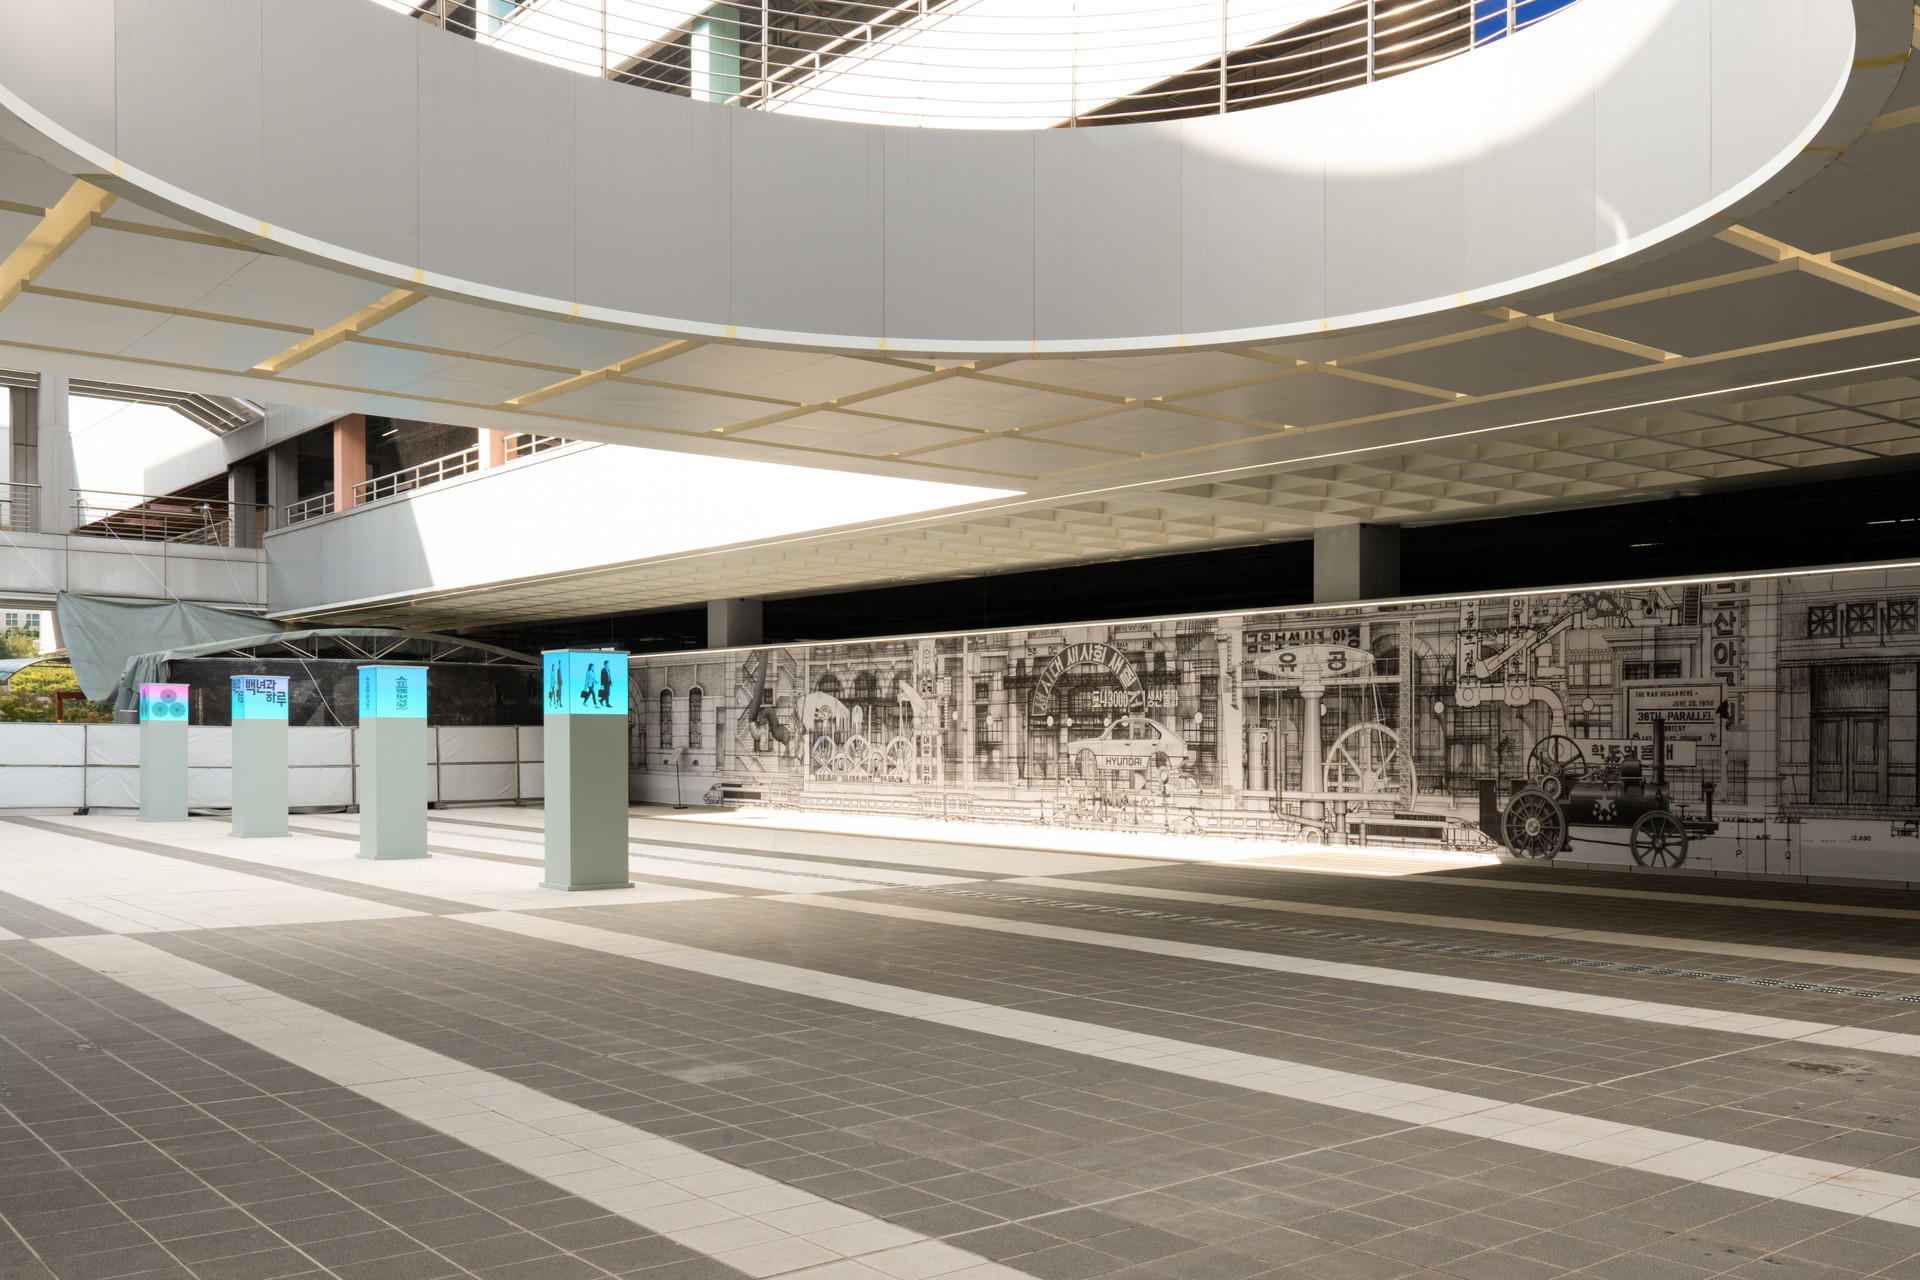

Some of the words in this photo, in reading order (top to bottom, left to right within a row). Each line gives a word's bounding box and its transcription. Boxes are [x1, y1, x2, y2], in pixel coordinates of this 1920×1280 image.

[1035, 656, 1064, 712] 새시대
[1067, 643, 1108, 665] 새사회
[245, 678, 277, 695] 백년과
[265, 690, 287, 707] 하루
[1667, 711, 1714, 721] PARALLEL
[1105, 757, 1143, 766] HYUNDAI
